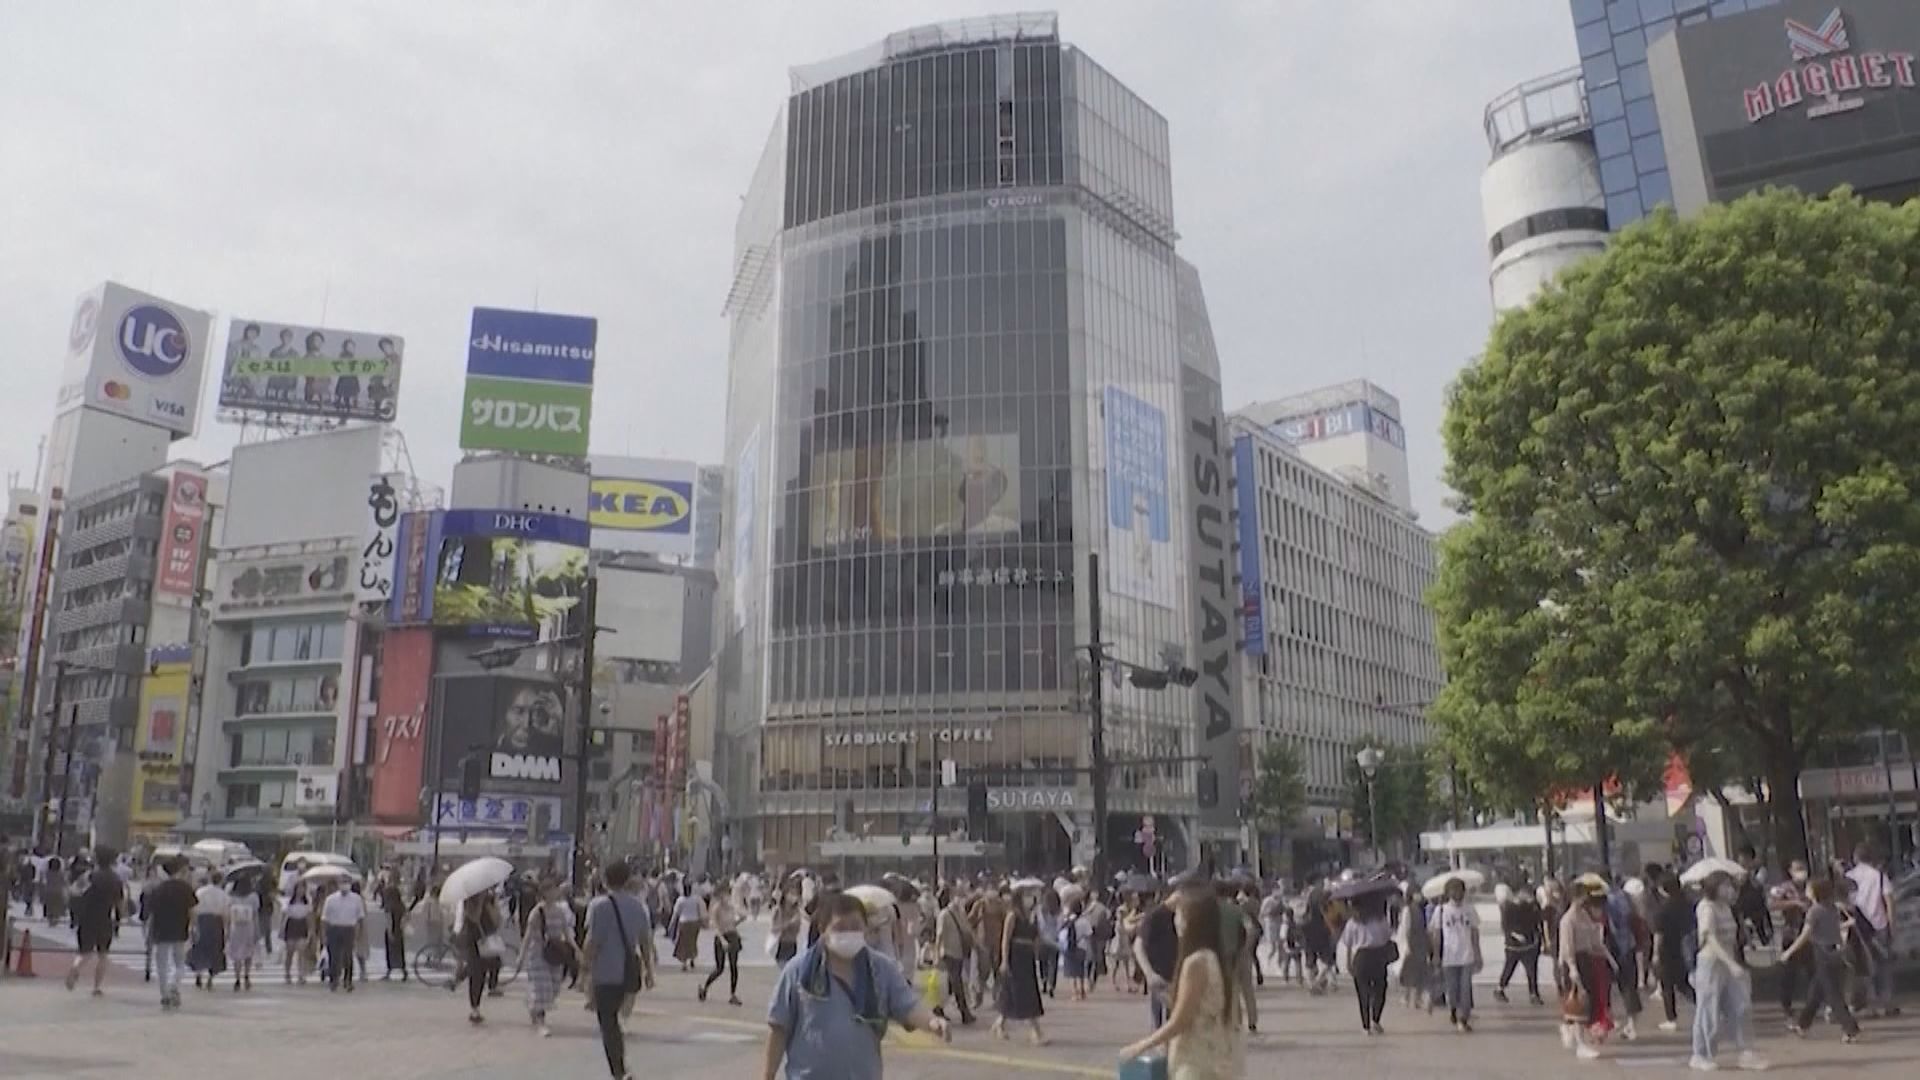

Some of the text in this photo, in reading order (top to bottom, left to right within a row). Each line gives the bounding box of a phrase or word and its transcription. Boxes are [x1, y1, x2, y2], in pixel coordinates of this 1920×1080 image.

[1743, 52, 1916, 122] MAGNET
[123, 315, 182, 363] UC
[472, 333, 593, 360] Hisamitsu
[155, 399, 185, 417] VISA
[590, 492, 679, 516] KEA
[361, 476, 398, 596] もんじゃ
[494, 514, 541, 532] DHC
[1191, 416, 1232, 741] TSUTAYA
[491, 752, 561, 782] DMM
[986, 789, 1073, 809] SUTAYA
